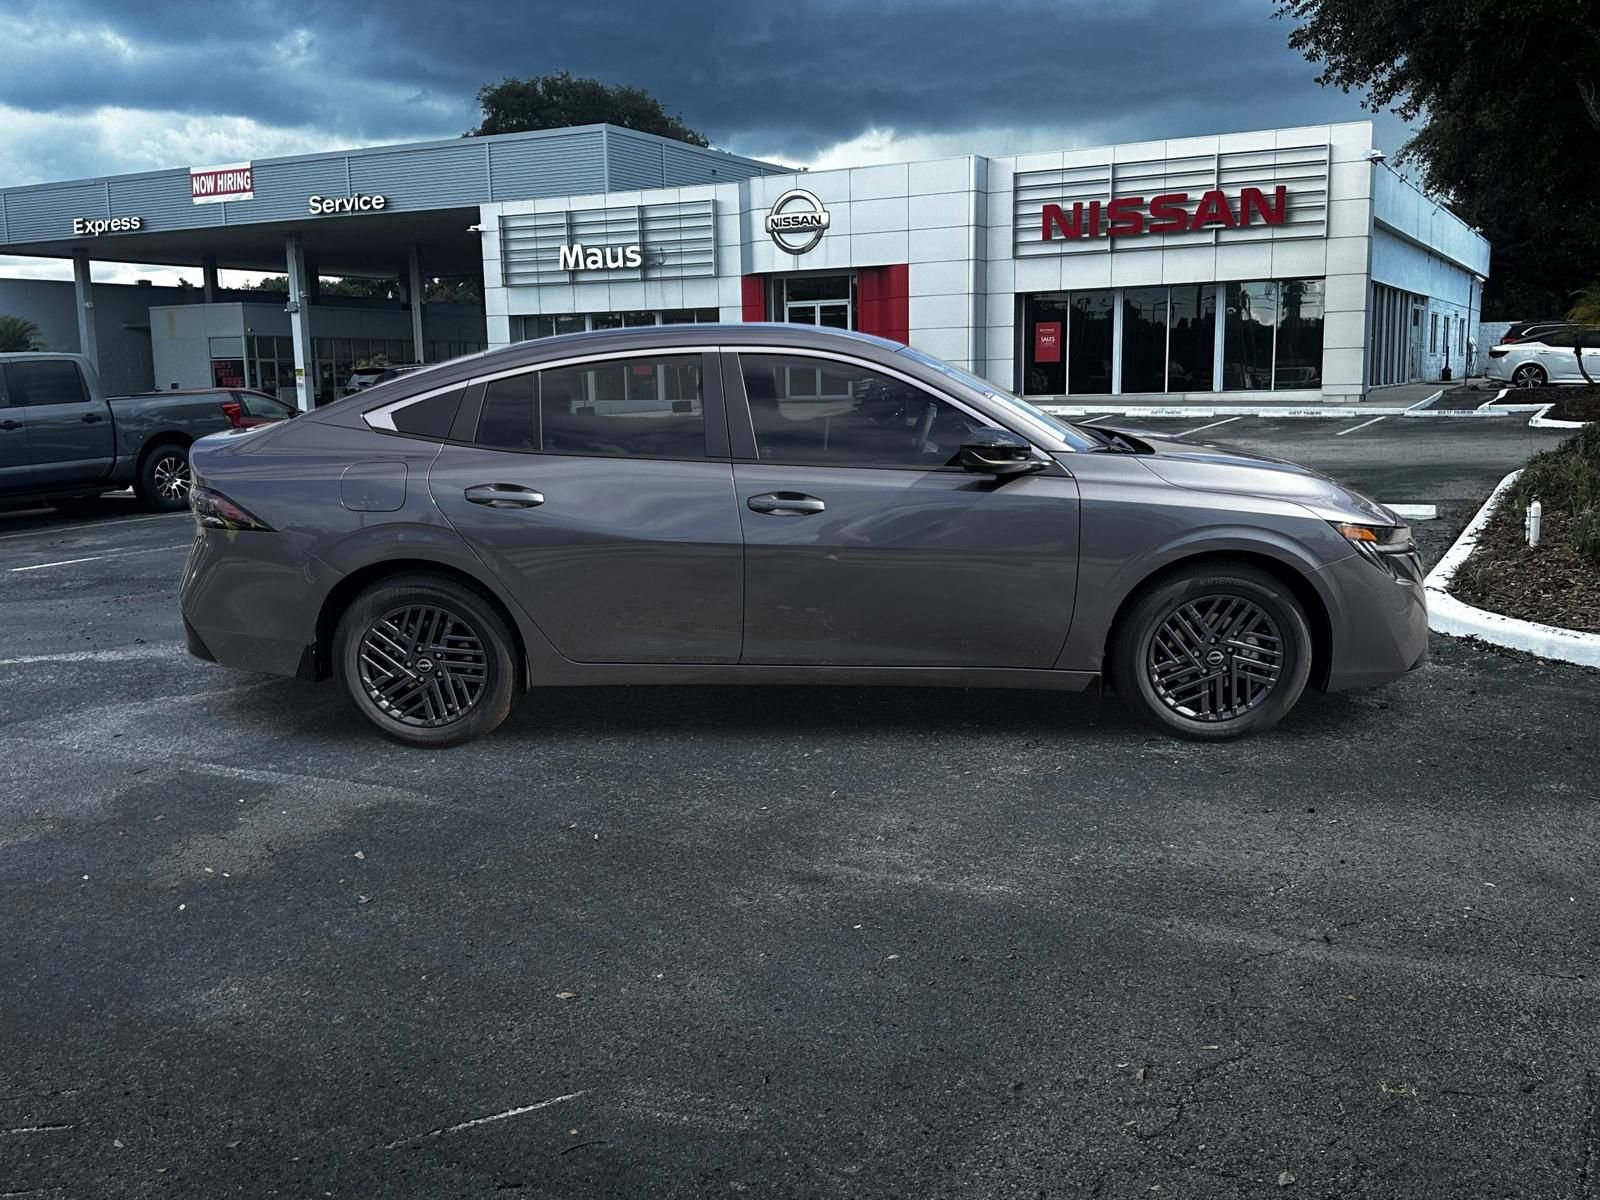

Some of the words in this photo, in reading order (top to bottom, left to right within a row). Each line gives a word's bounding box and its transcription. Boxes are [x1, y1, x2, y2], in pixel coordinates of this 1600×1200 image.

[192, 174, 215, 195] NOW
[217, 171, 251, 192] HIRING
[309, 193, 385, 214] Service
[1042, 185, 1287, 241] NISSAN
[73, 217, 140, 236] Express
[770, 215, 822, 228] NISSAN
[560, 244, 642, 270] Maus
